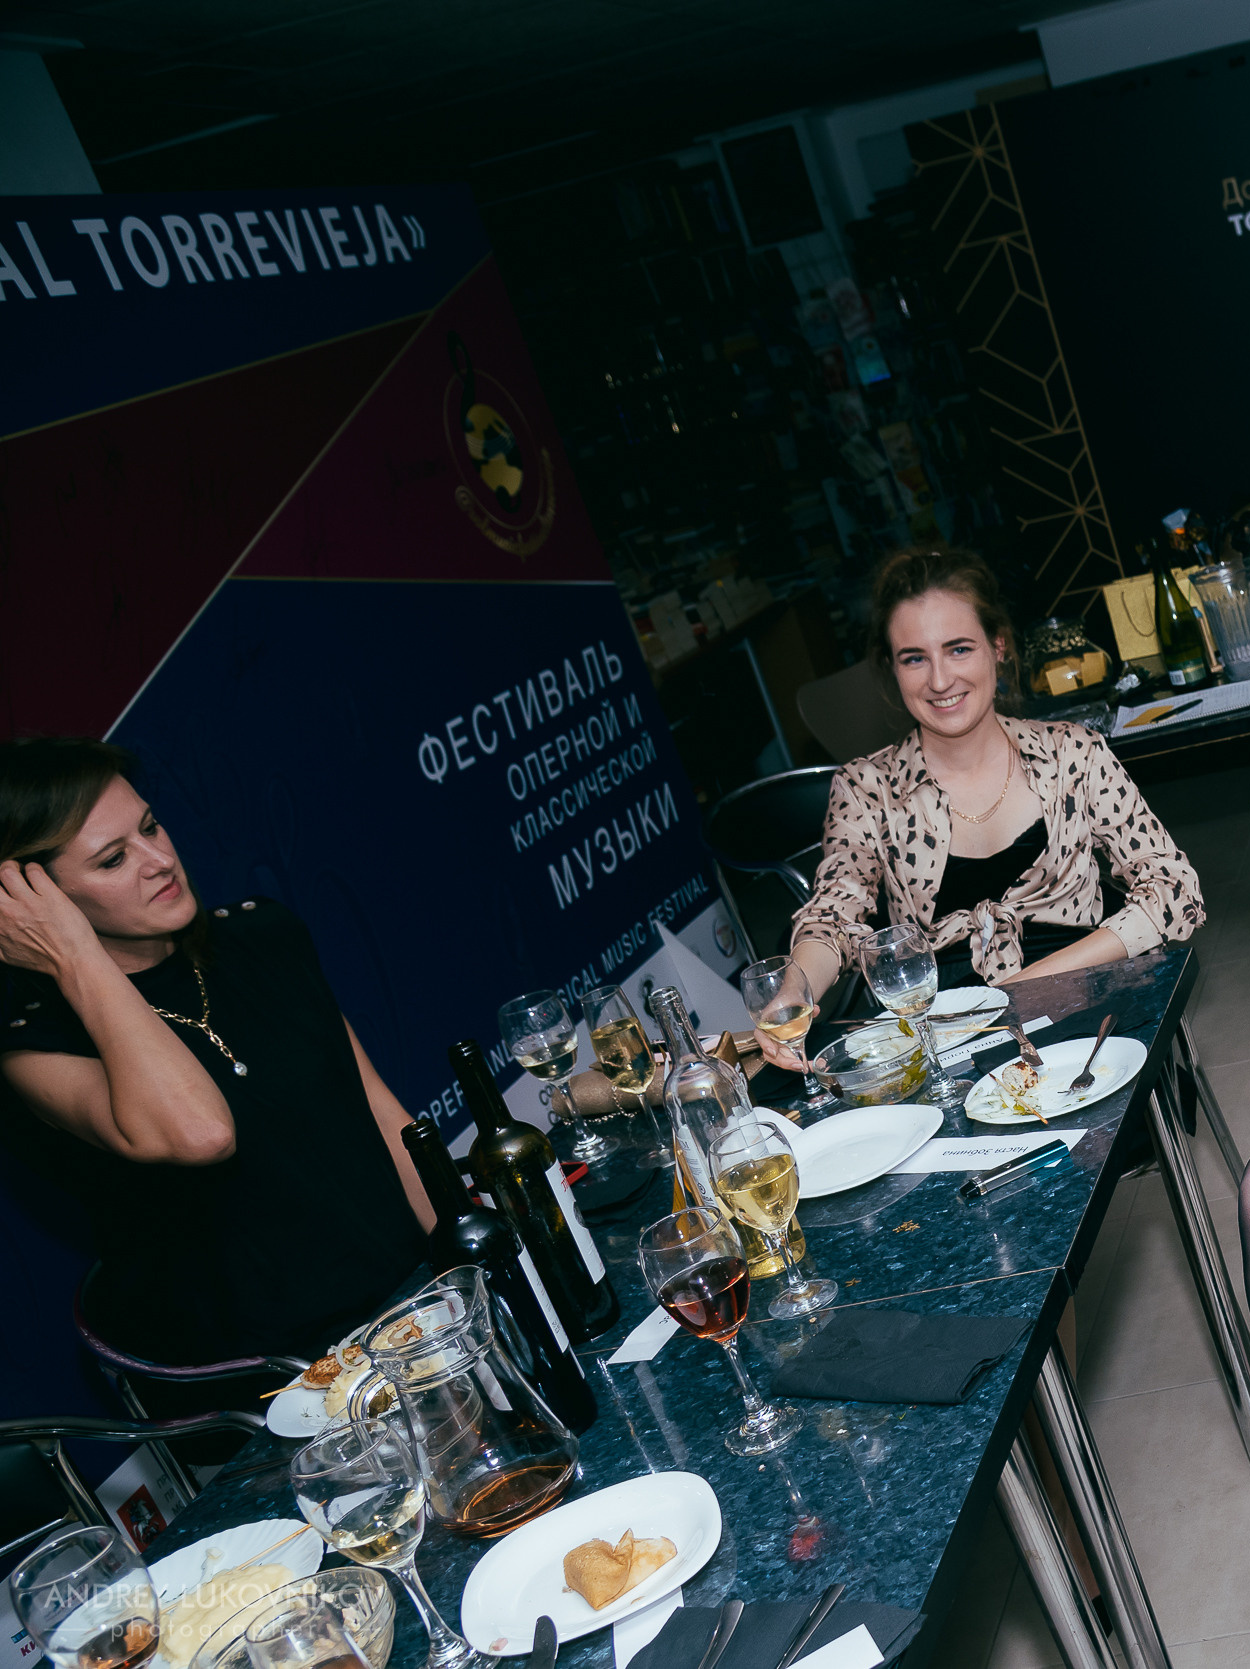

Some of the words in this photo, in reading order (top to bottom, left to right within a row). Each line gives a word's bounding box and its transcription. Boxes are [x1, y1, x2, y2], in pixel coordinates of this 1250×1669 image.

[71, 203, 427, 292] TORREVIEJA»
[417, 640, 624, 784] ФЕСТИВАЛЬ
[507, 700, 622, 802] ОПЕРНОЙ
[626, 693, 643, 726] И
[509, 732, 659, 853] КЛАССИЧЕСКОЙ
[547, 782, 680, 910] МУЗЫКИ
[600, 921, 647, 974] MUSIC
[647, 872, 709, 936] FESTIVAL
